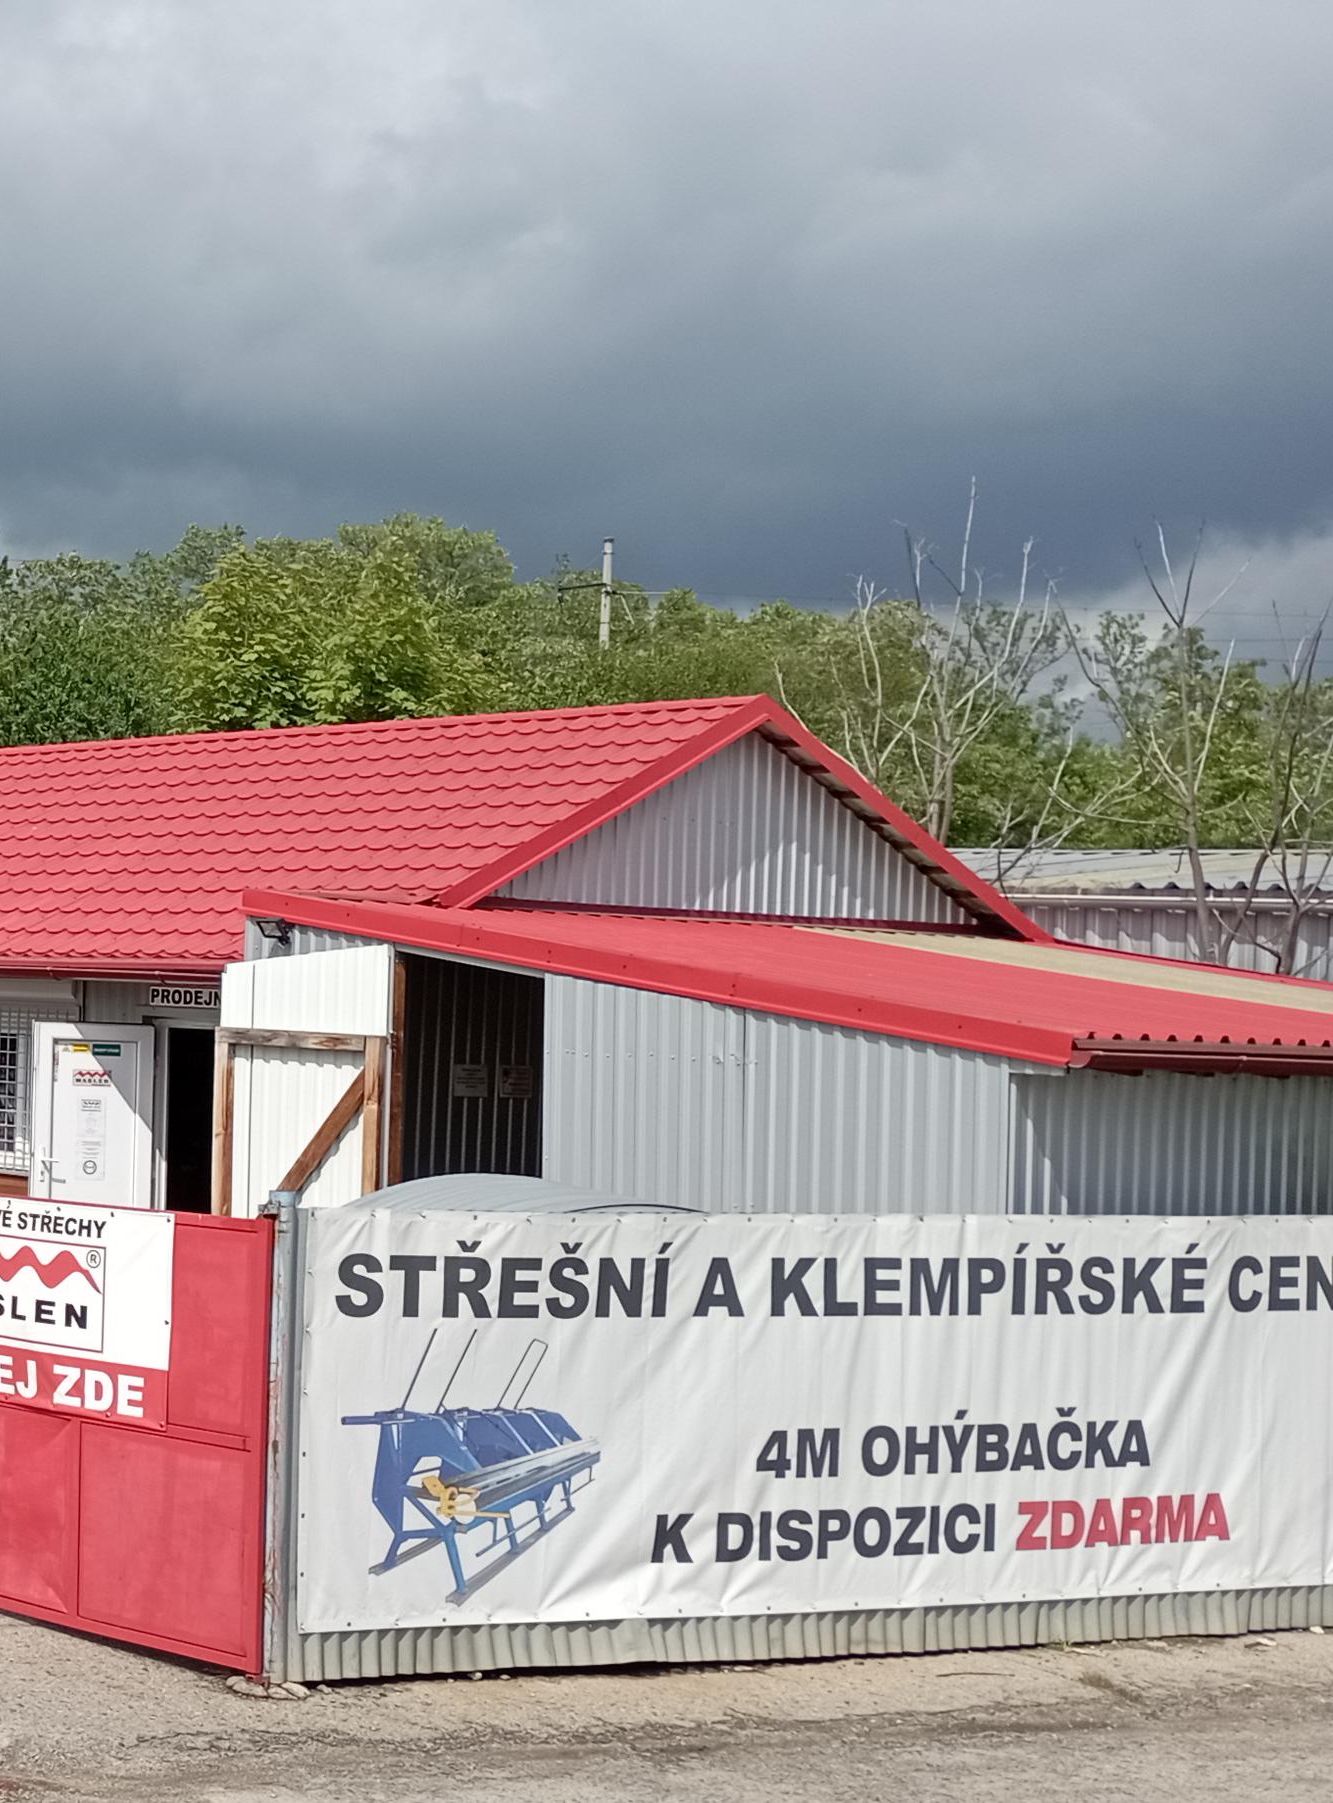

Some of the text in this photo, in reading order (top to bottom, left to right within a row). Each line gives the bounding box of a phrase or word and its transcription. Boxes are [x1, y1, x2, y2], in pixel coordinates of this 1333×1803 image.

[17, 1210, 107, 1239] STŘECHY
[335, 1240, 1333, 1319] STŘEŠNÍ A KLEMPÍŘSKÉ CEN
[53, 1364, 145, 1418] ZDE
[755, 1407, 1151, 1479] 4M OHÝBAČKA
[651, 1493, 1231, 1564] K DISPOZICI ZDARMA
